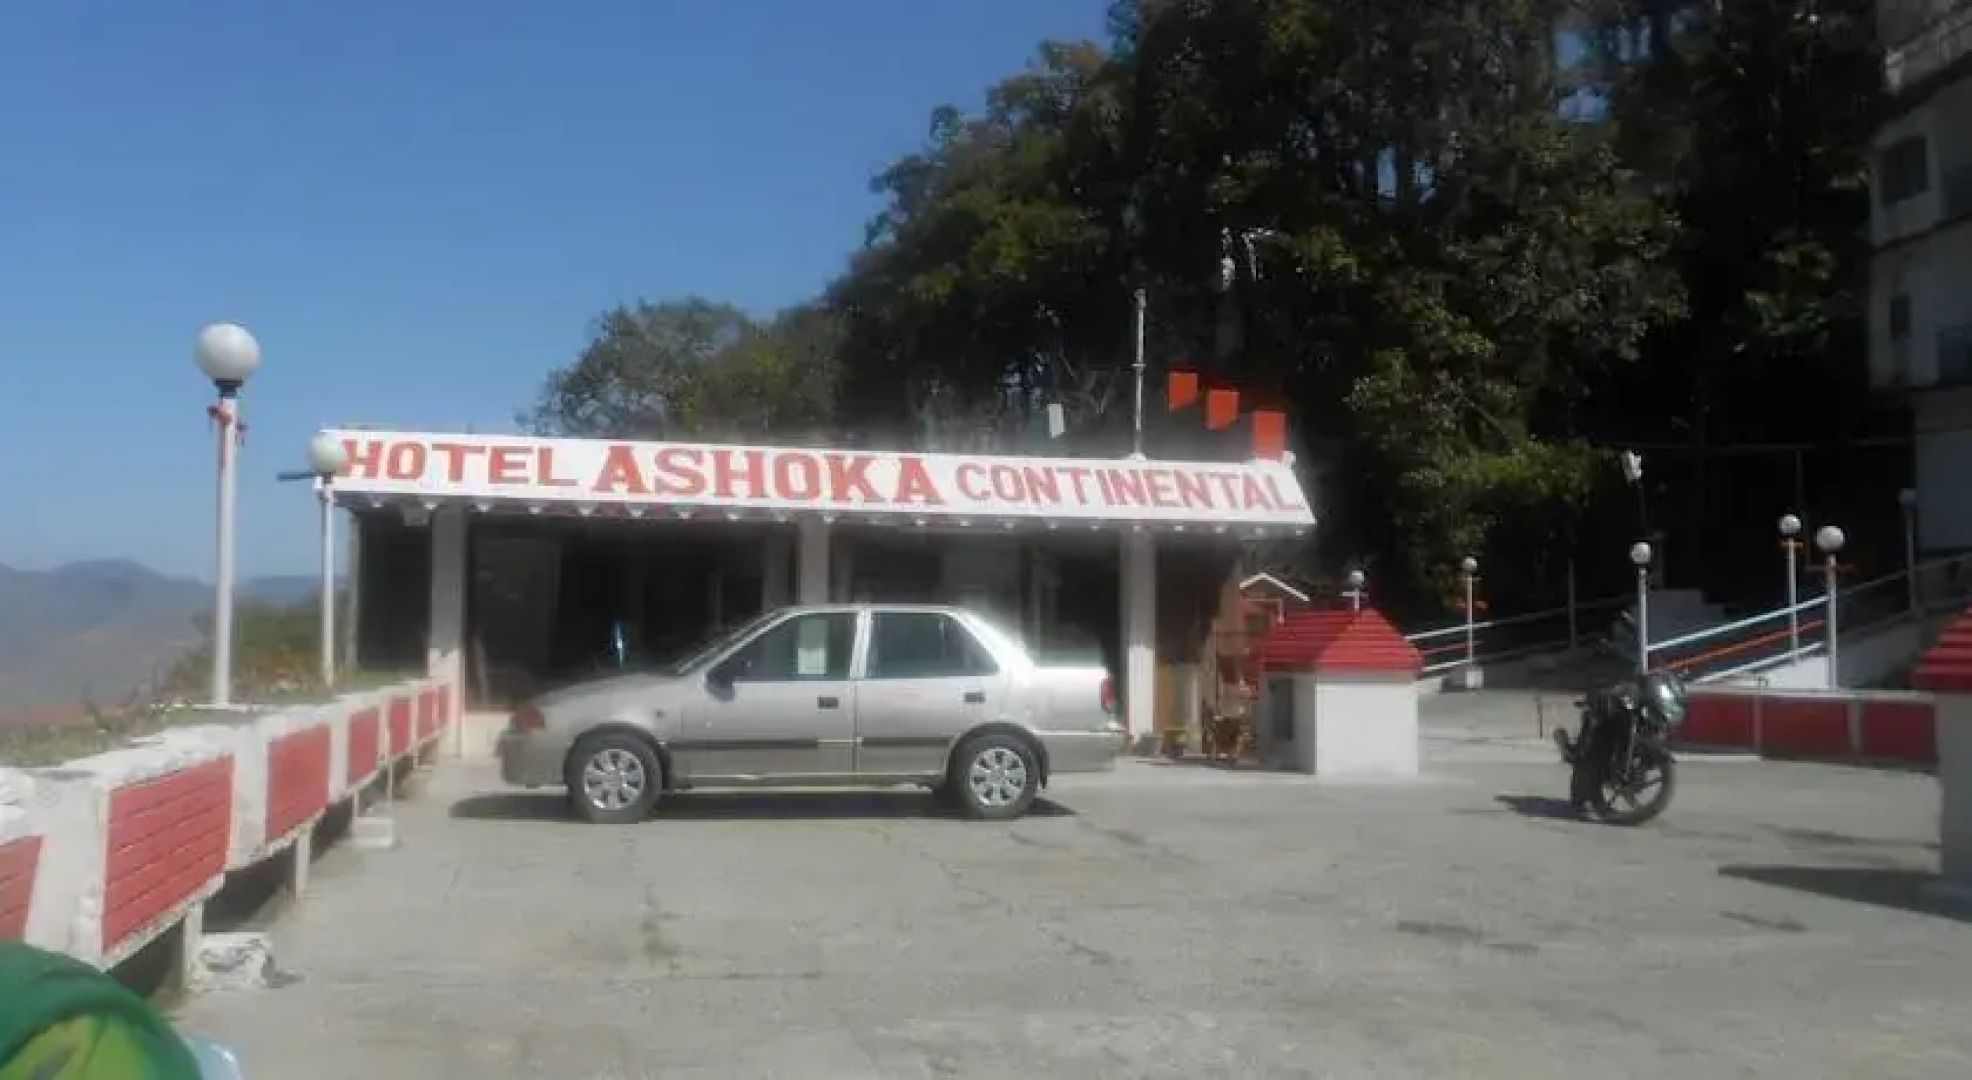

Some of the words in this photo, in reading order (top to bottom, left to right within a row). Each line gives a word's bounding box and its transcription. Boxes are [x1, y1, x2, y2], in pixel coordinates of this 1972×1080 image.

[341, 439, 578, 486] HOTEL
[591, 445, 944, 505] ASHOKA
[955, 463, 1305, 510] CONTINENTAL
